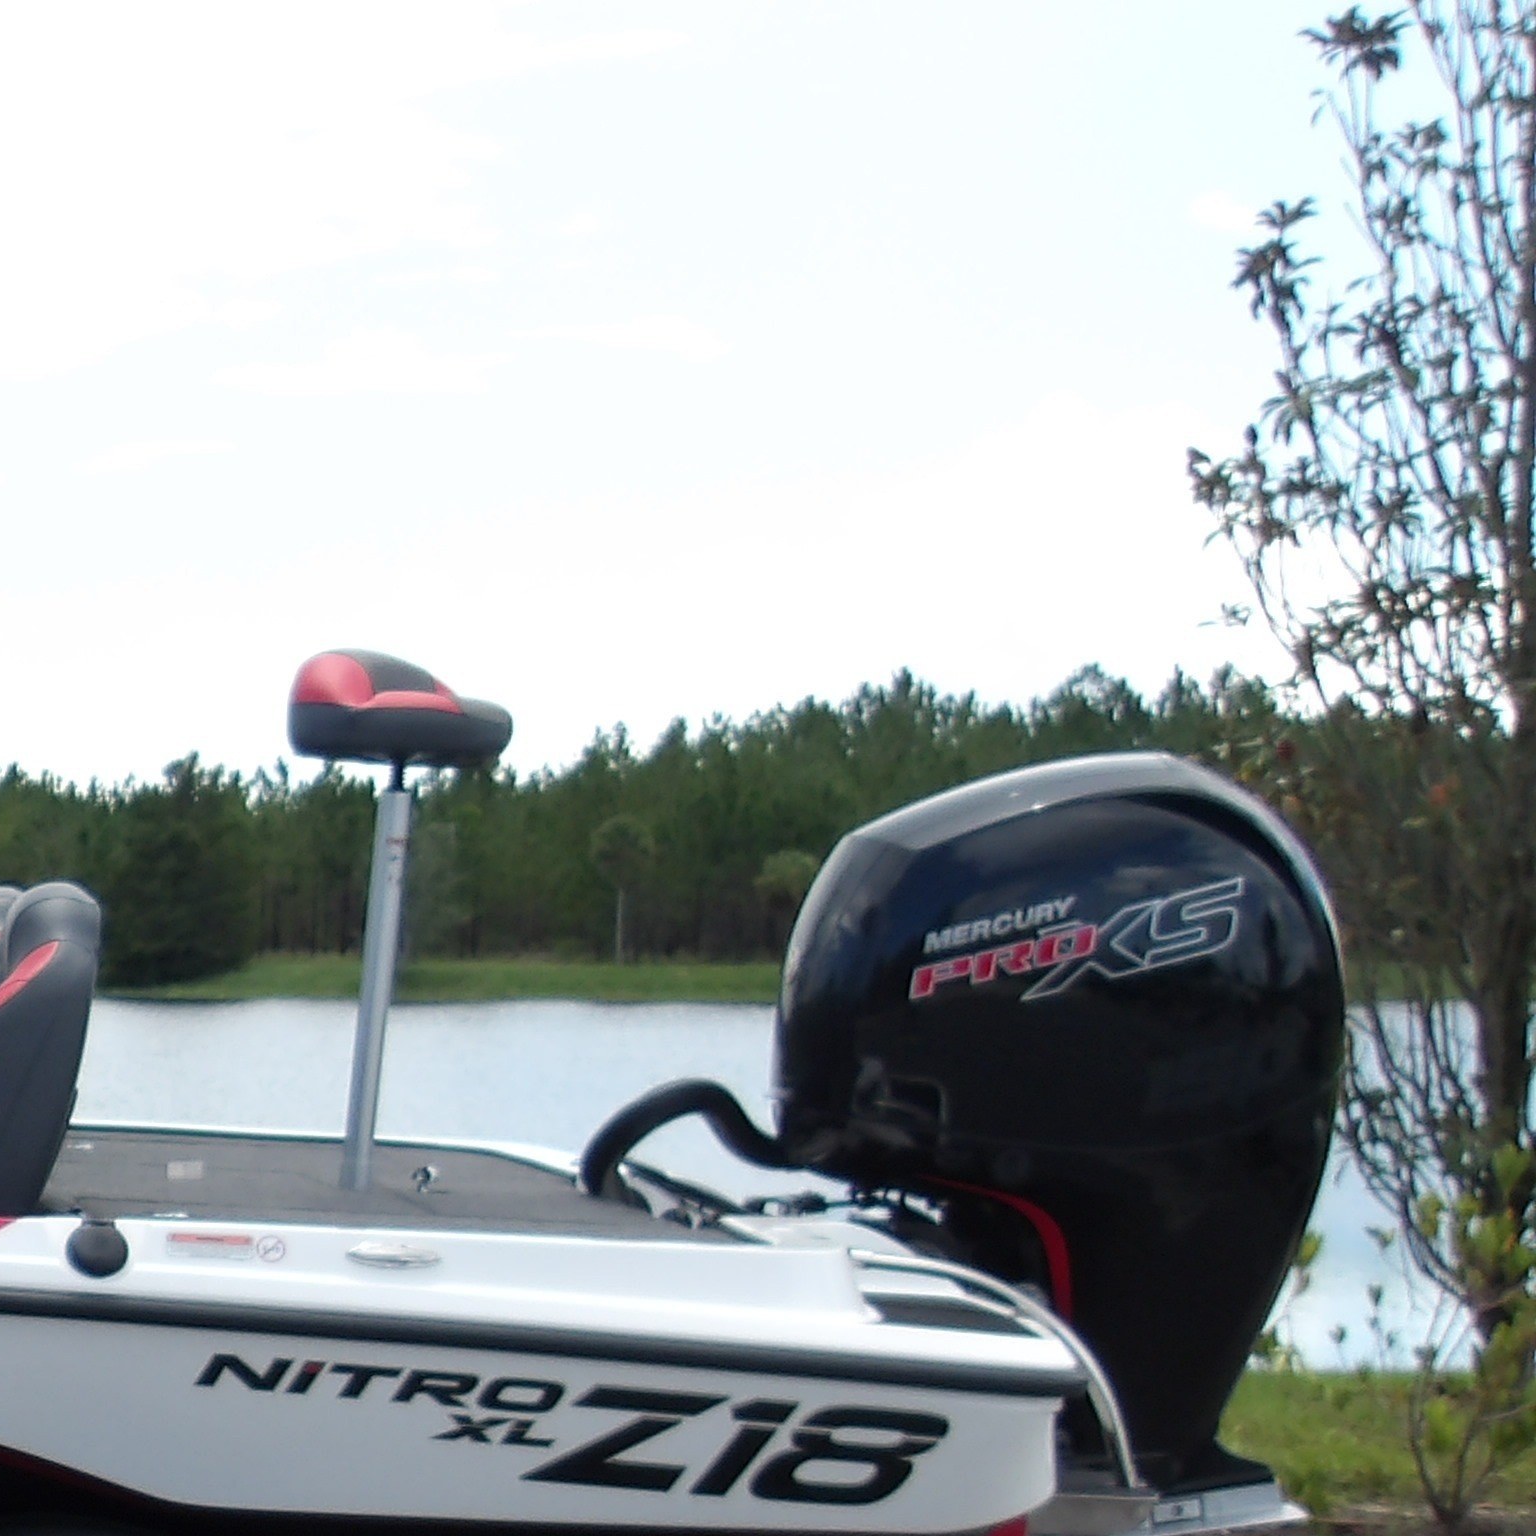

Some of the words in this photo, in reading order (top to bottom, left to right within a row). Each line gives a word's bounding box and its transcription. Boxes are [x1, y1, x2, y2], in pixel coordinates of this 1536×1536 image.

[923, 896, 1077, 954] MERCURY
[431, 1413, 557, 1448] XL
[519, 1384, 950, 1506] Z18
